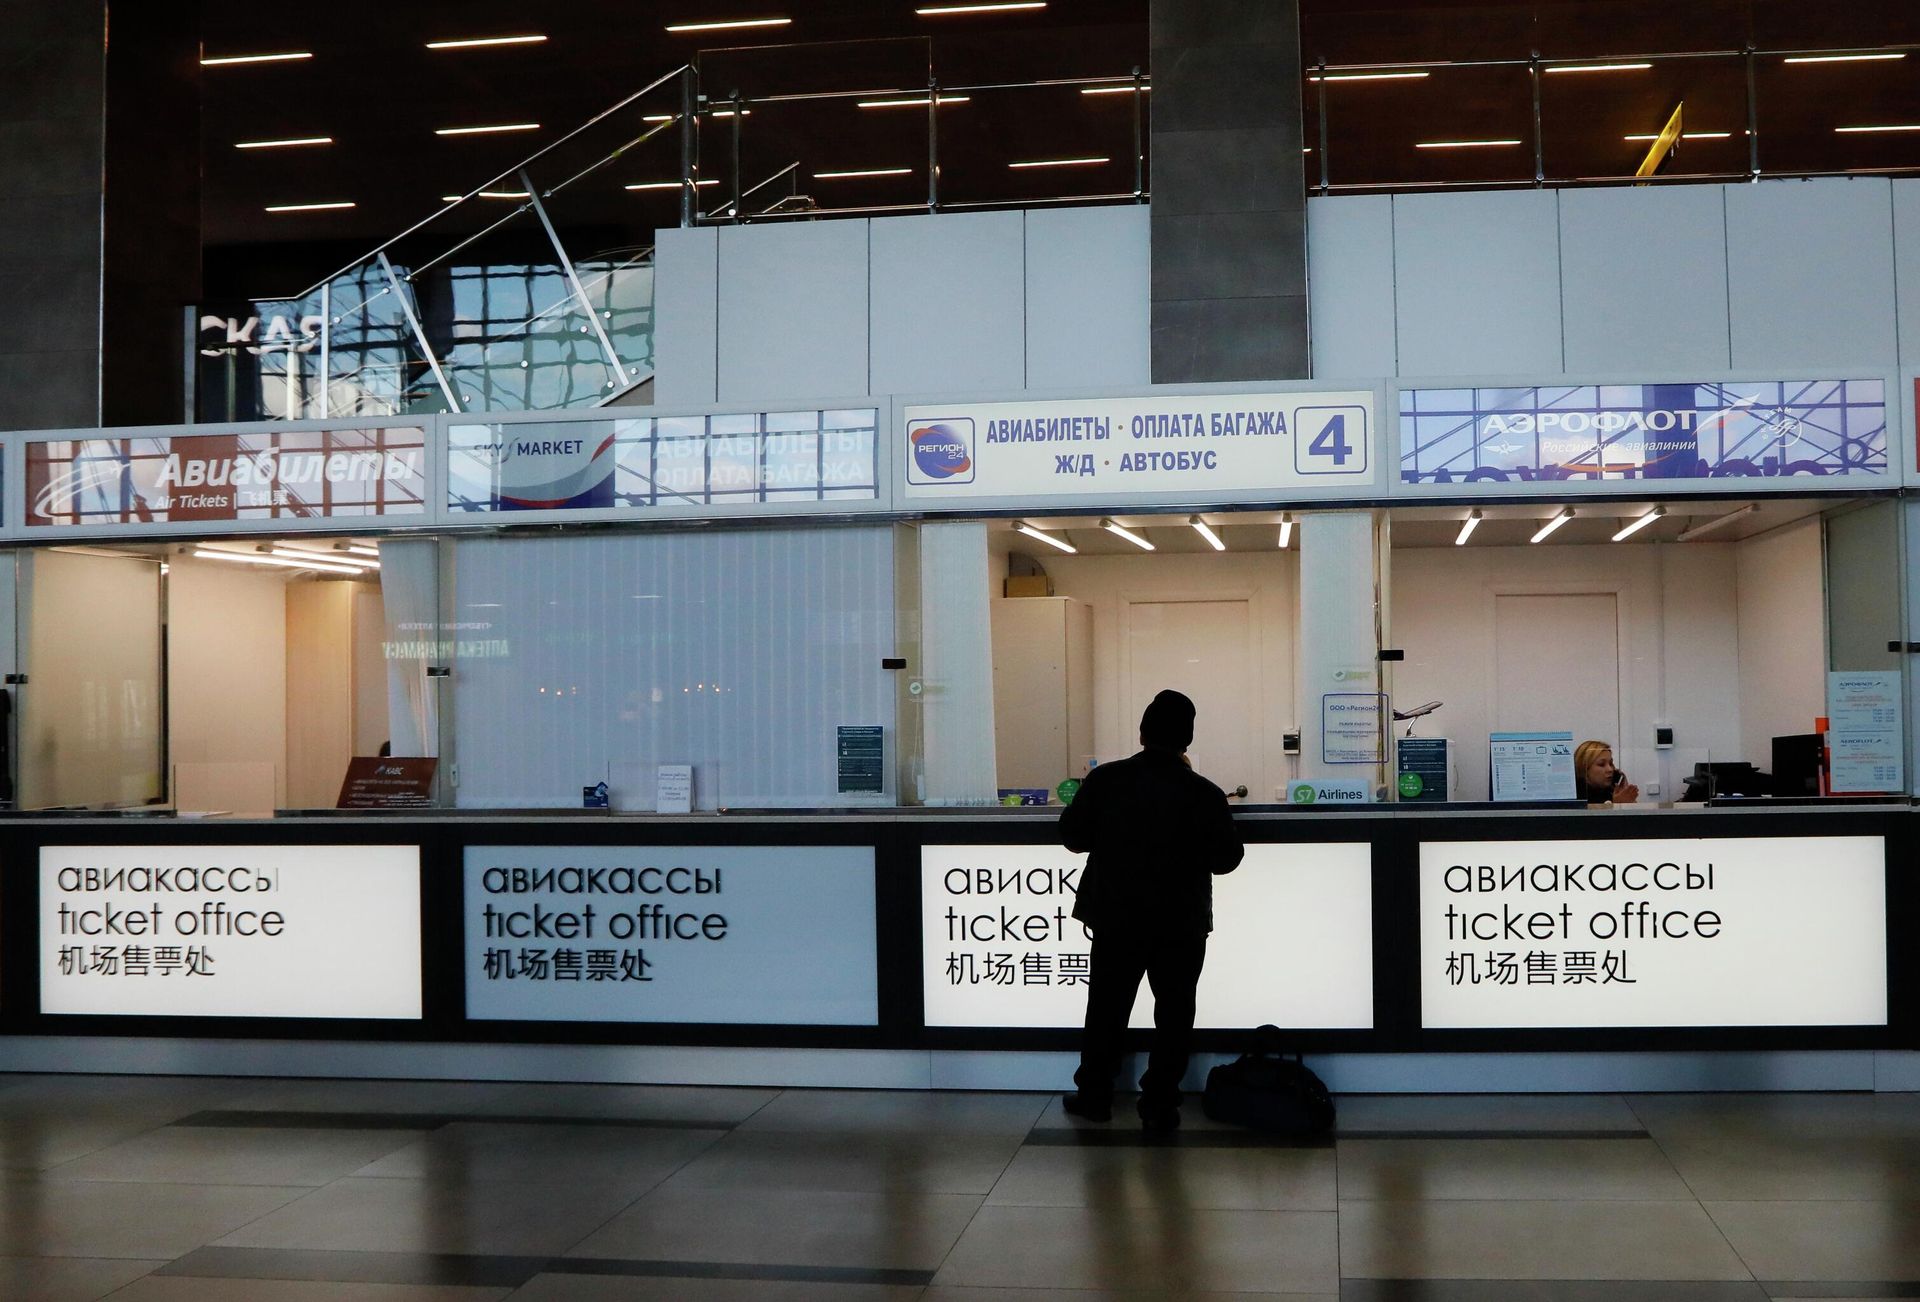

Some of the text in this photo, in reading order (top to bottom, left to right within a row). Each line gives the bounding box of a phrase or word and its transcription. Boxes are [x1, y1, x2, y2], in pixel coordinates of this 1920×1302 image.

[986, 411, 1287, 443] АВИАБИЛЕТЫ ОПЛАТА БАГАЖА
[1484, 409, 1697, 434] АЭРОФЛОТ
[473, 440, 583, 459] SKY MARKET
[653, 430, 863, 459] АВИАБИЛЕТЫ
[918, 443, 965, 454] РЕГИОН
[1308, 414, 1353, 465] 4
[1542, 439, 1696, 453] Российские авиалинии
[155, 446, 417, 489] Авиабилеты
[947, 450, 965, 460] 24
[1055, 450, 1217, 476] Ж/Д АВТОБУС
[653, 461, 863, 487] ОПЛАТА БАГАЖА
[155, 494, 228, 509] Air Tickets
[1295, 789, 1363, 804] S7 Airlines
[482, 866, 721, 894] авиакассы
[944, 867, 1078, 895] авиак
[1444, 862, 1714, 893] авиакассы
[58, 902, 285, 936] ticket office
[483, 903, 728, 940] ticket office
[945, 905, 1067, 941] ticket
[1445, 901, 1722, 940] ticket office
[482, 948, 653, 982] 机场售票处
[945, 952, 1091, 986] 机场售票
[1445, 949, 1637, 985] 机场售票处
